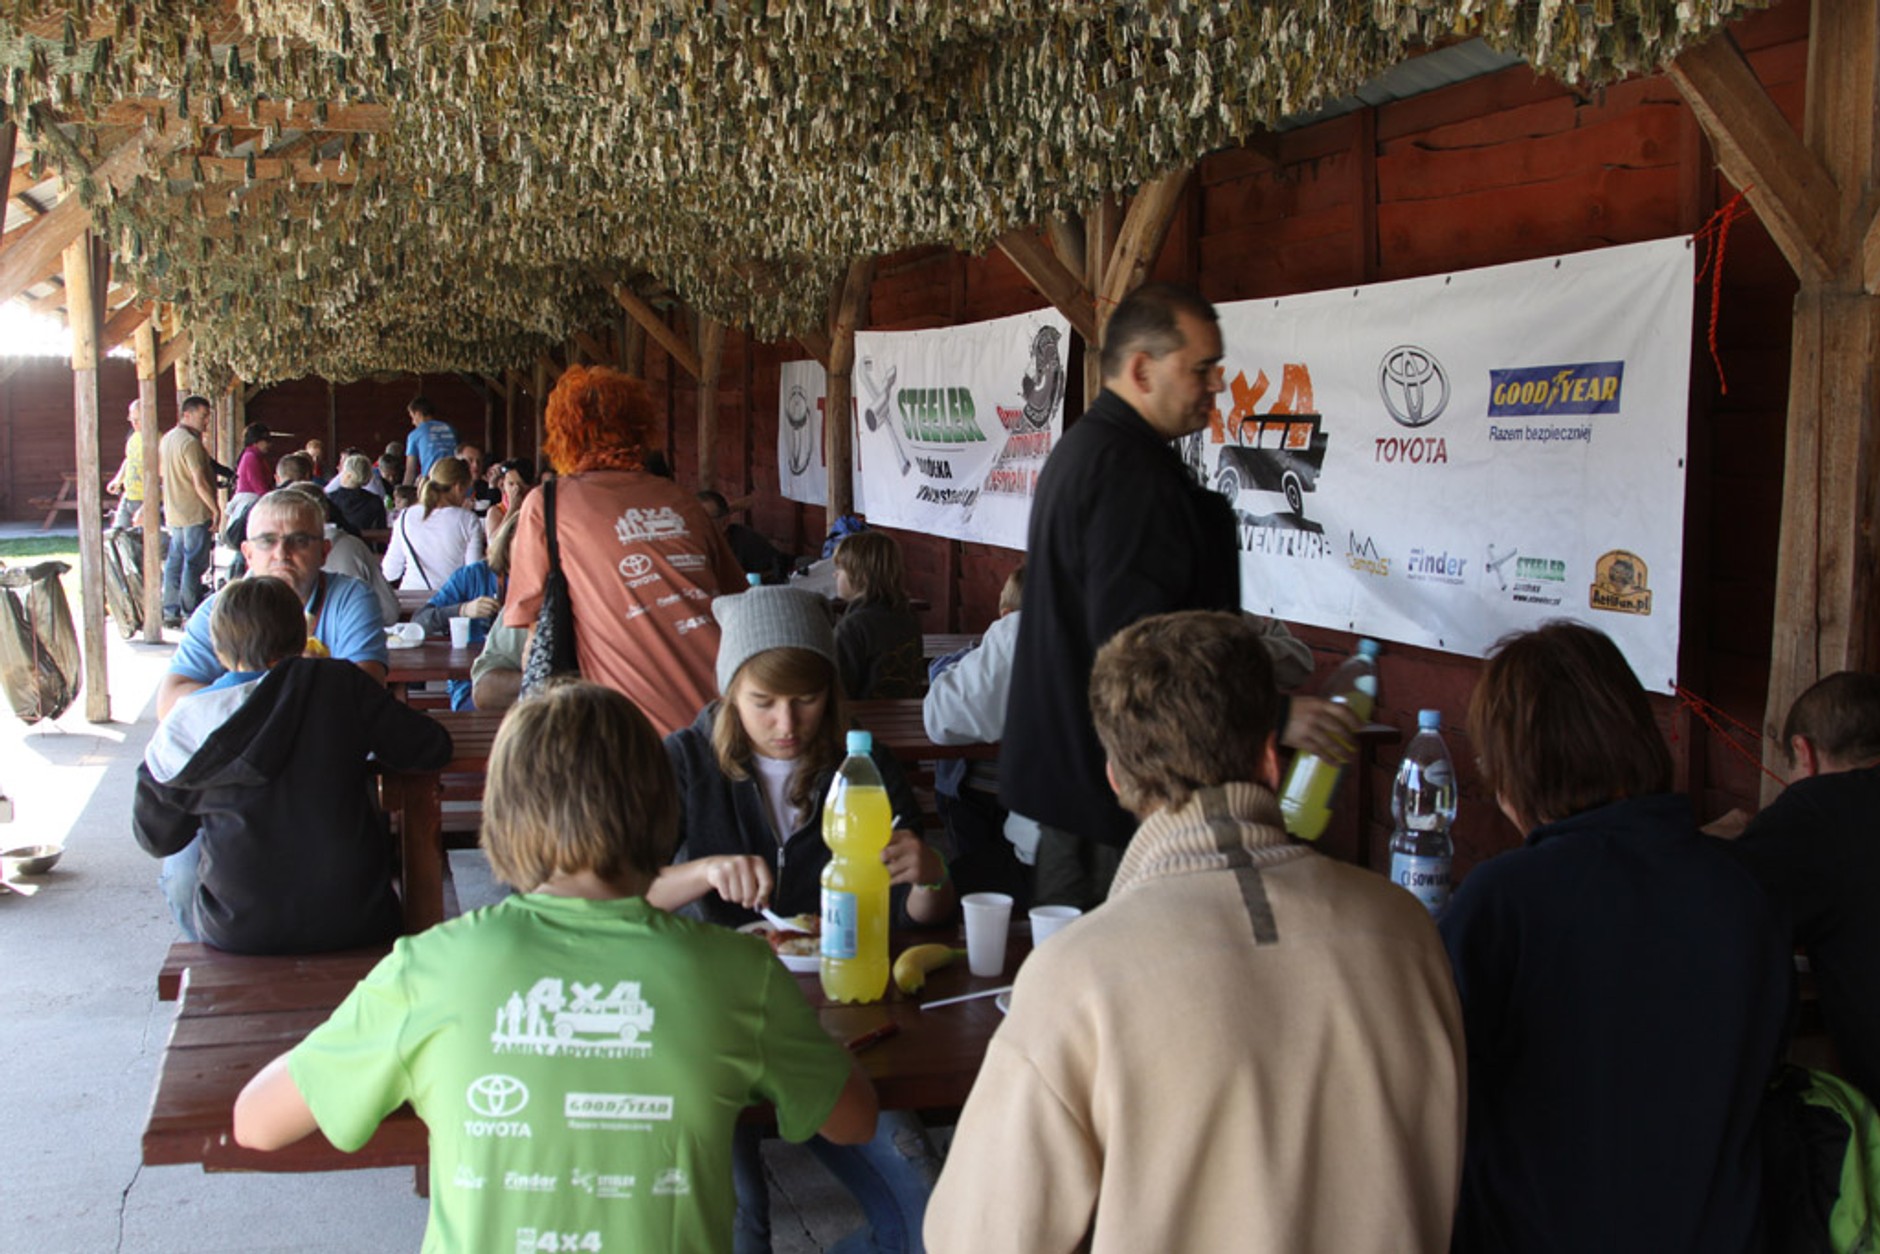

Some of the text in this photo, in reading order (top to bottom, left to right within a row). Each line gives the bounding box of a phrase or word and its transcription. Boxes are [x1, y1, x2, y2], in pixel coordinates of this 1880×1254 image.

[1494, 371, 1618, 409] GOODYEAR
[898, 387, 987, 443] STEELER
[1489, 423, 1592, 443] Razem bezpieczniej
[1375, 437, 1447, 464] TOYOTA
[1408, 547, 1467, 576] Finder
[569, 1097, 670, 1114] GOODYEAR
[464, 1120, 532, 1137] TOYOTA
[537, 1230, 602, 1252] 4x4
